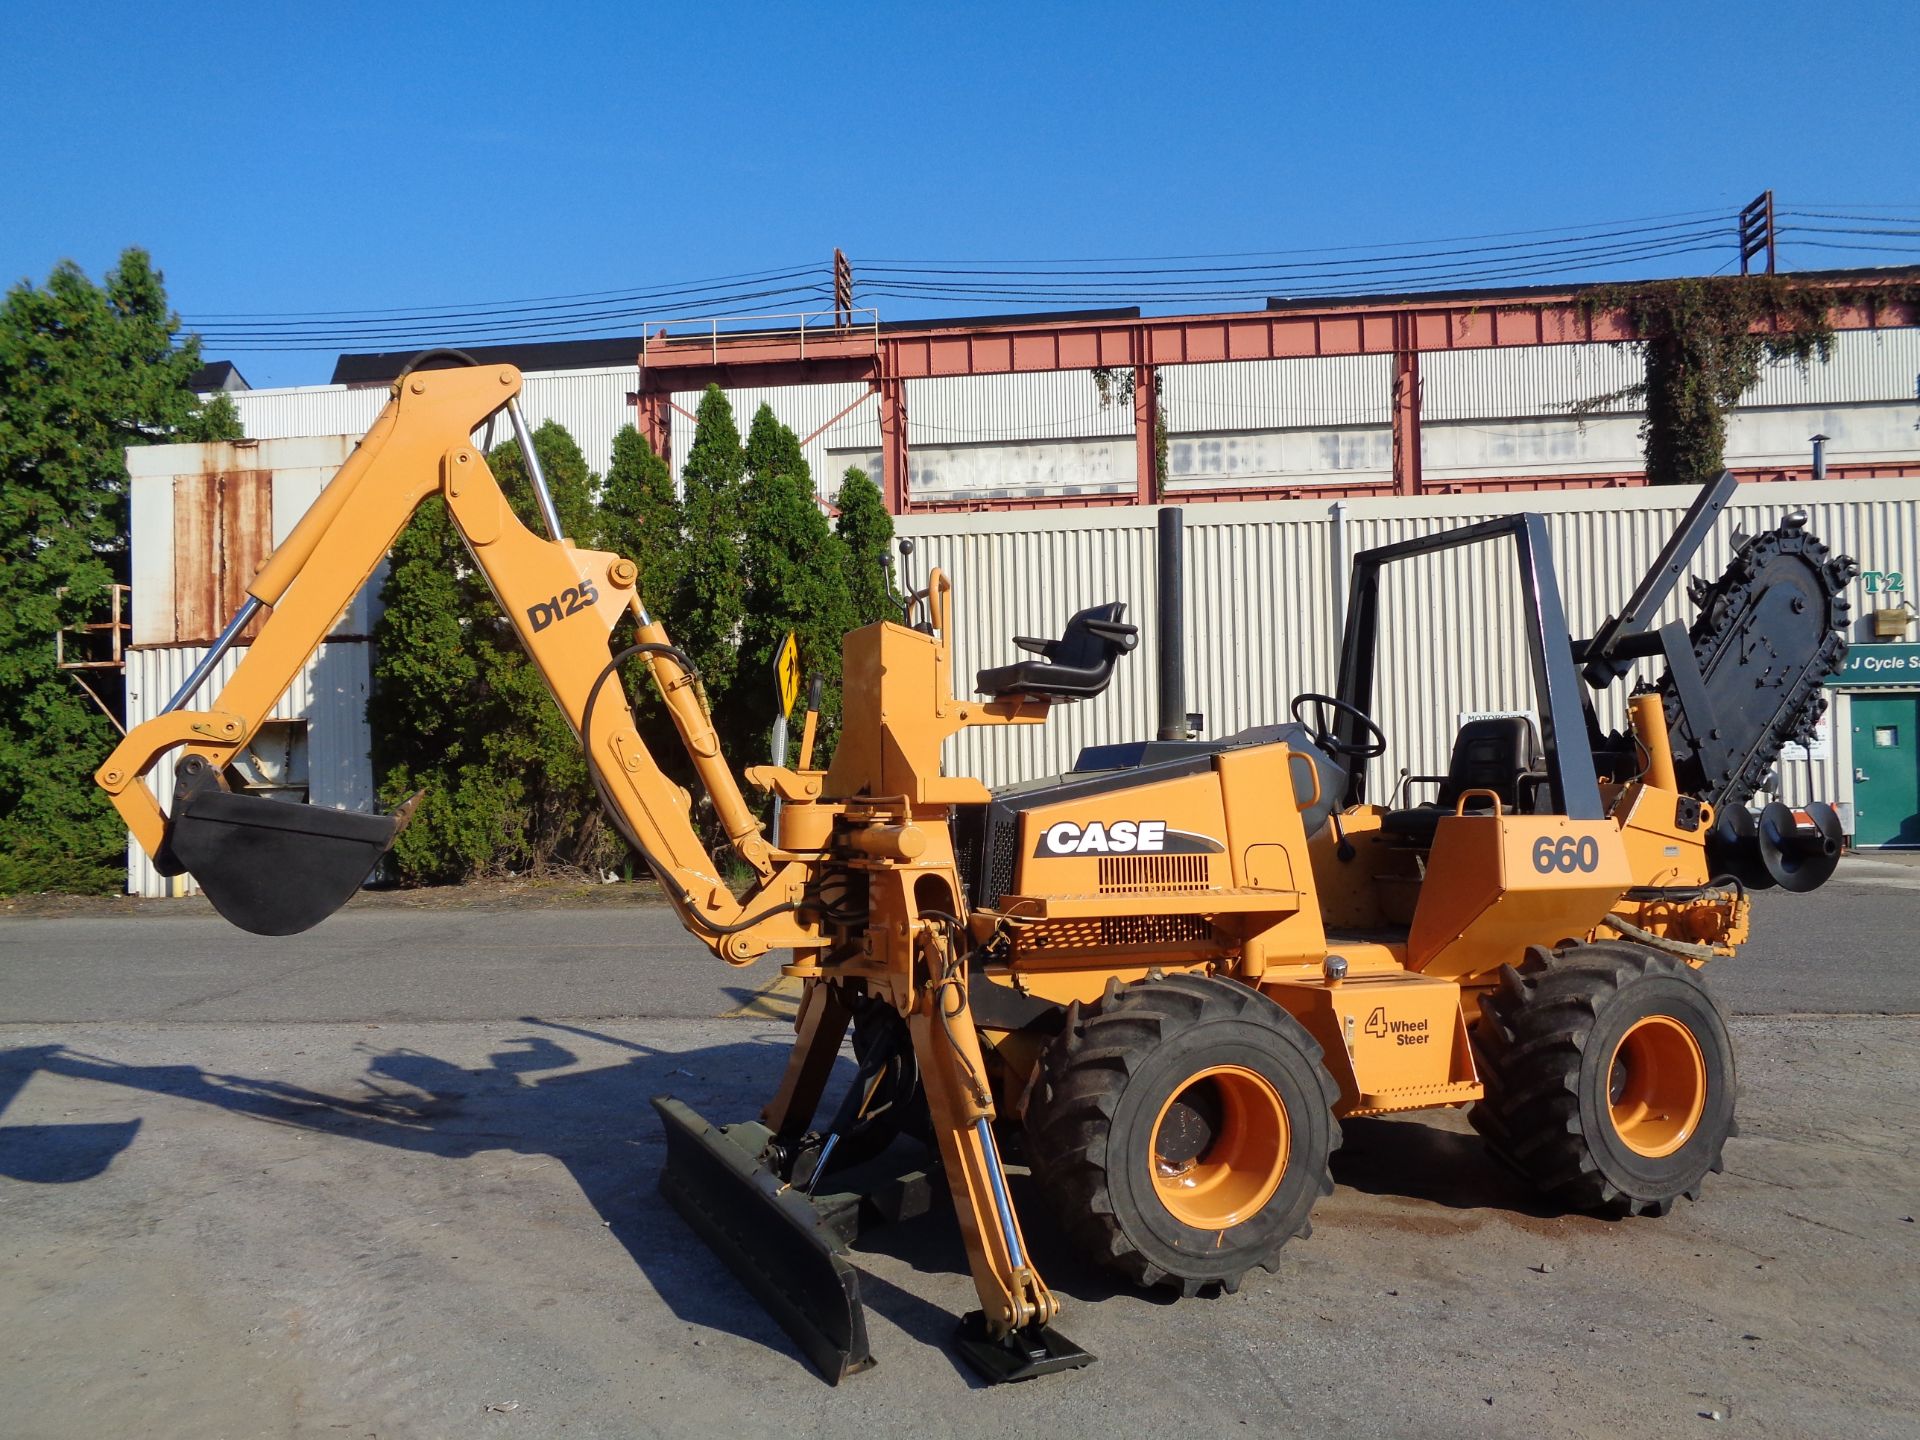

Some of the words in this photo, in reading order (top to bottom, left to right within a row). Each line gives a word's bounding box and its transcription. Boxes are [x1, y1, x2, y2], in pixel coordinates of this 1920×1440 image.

[526, 578, 599, 633] D125
[1851, 657, 1861, 669] J
[1864, 656, 1905, 672] Cycle
[1909, 656, 1920, 669] S
[1468, 714, 1529, 722] MOTORC
[1046, 820, 1166, 854] CASE
[1532, 835, 1599, 874] 660
[1365, 1007, 1388, 1039] 4
[1390, 1019, 1428, 1033] Wheel
[1396, 1033, 1430, 1046] Steer
